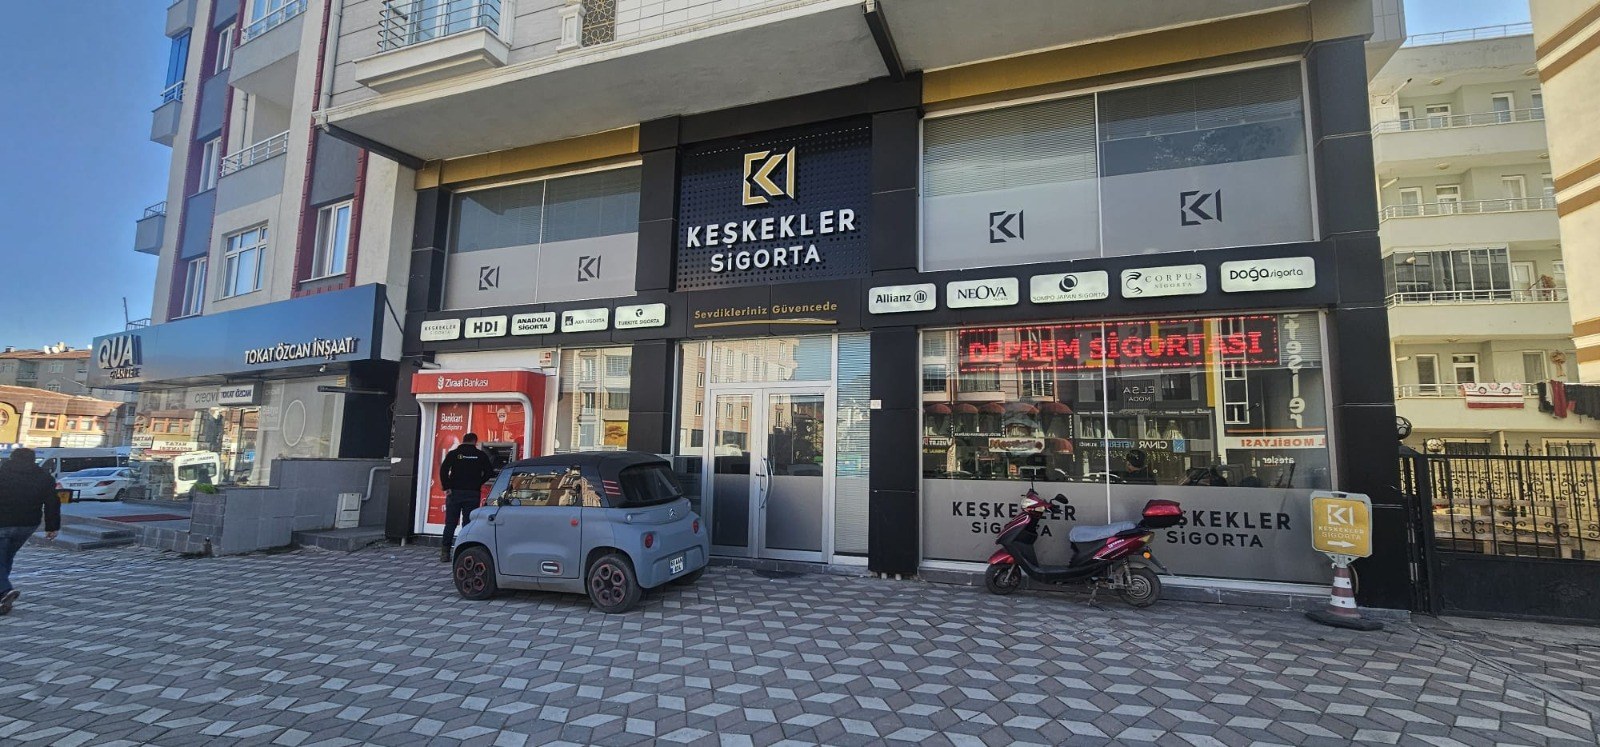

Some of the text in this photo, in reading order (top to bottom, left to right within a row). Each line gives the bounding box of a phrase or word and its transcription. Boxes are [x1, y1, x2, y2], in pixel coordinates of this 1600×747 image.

[687, 208, 855, 249] KEŞKEKLER
[1145, 272, 1202, 284] CORPUS
[875, 293, 911, 304] Allianz
[957, 285, 1007, 300] NEOVA
[694, 301, 838, 319] Sevdikleriniz Güvencede
[473, 321, 498, 334] HDI
[517, 316, 551, 325] ANADOLU
[98, 334, 133, 369] QUA
[244, 337, 355, 365] TOKAT ÖZCAN İNŞAAT
[968, 330, 1263, 363] DEPREM SİGORTASI
[445, 379, 489, 388] Ziraat Bankası
[952, 501, 1077, 521] KEŞKEER
[1178, 509, 1292, 531] ŞKEKLER
[971, 521, 1053, 537] SİGA
